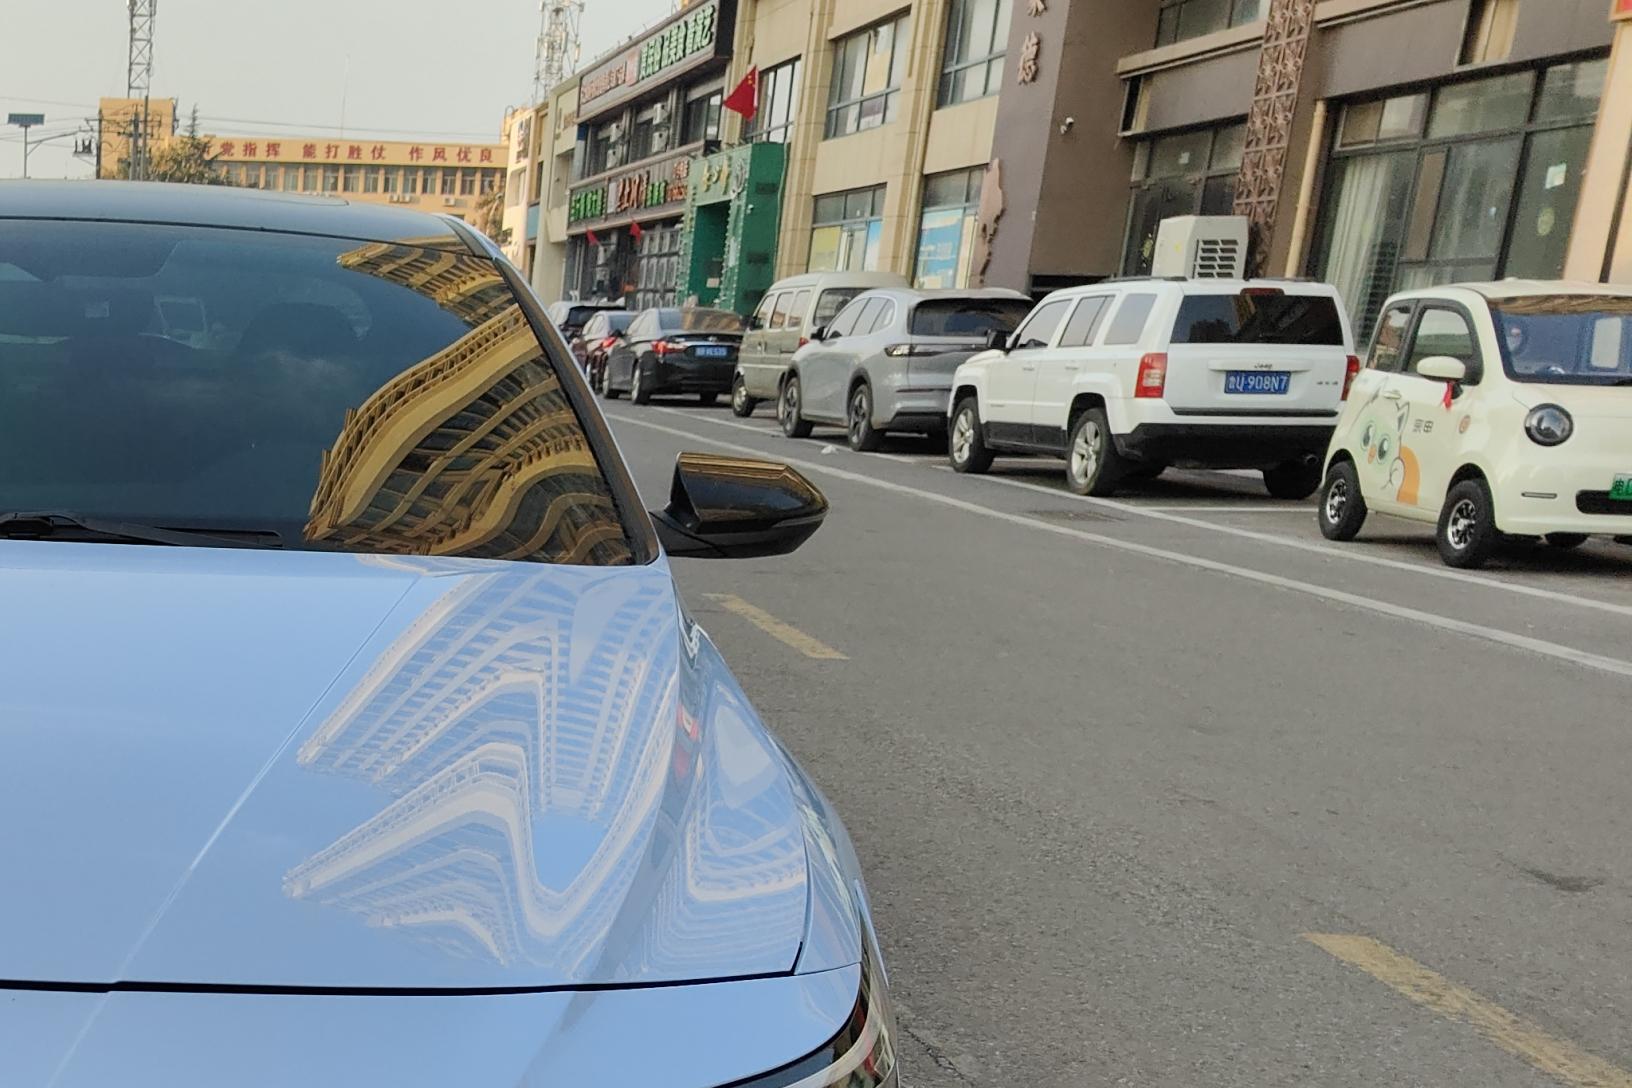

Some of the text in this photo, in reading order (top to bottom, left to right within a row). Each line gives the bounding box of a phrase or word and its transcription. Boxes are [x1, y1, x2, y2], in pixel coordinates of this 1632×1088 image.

[302, 143, 387, 161] 能打胜仗
[408, 145, 494, 163] 作风优良
